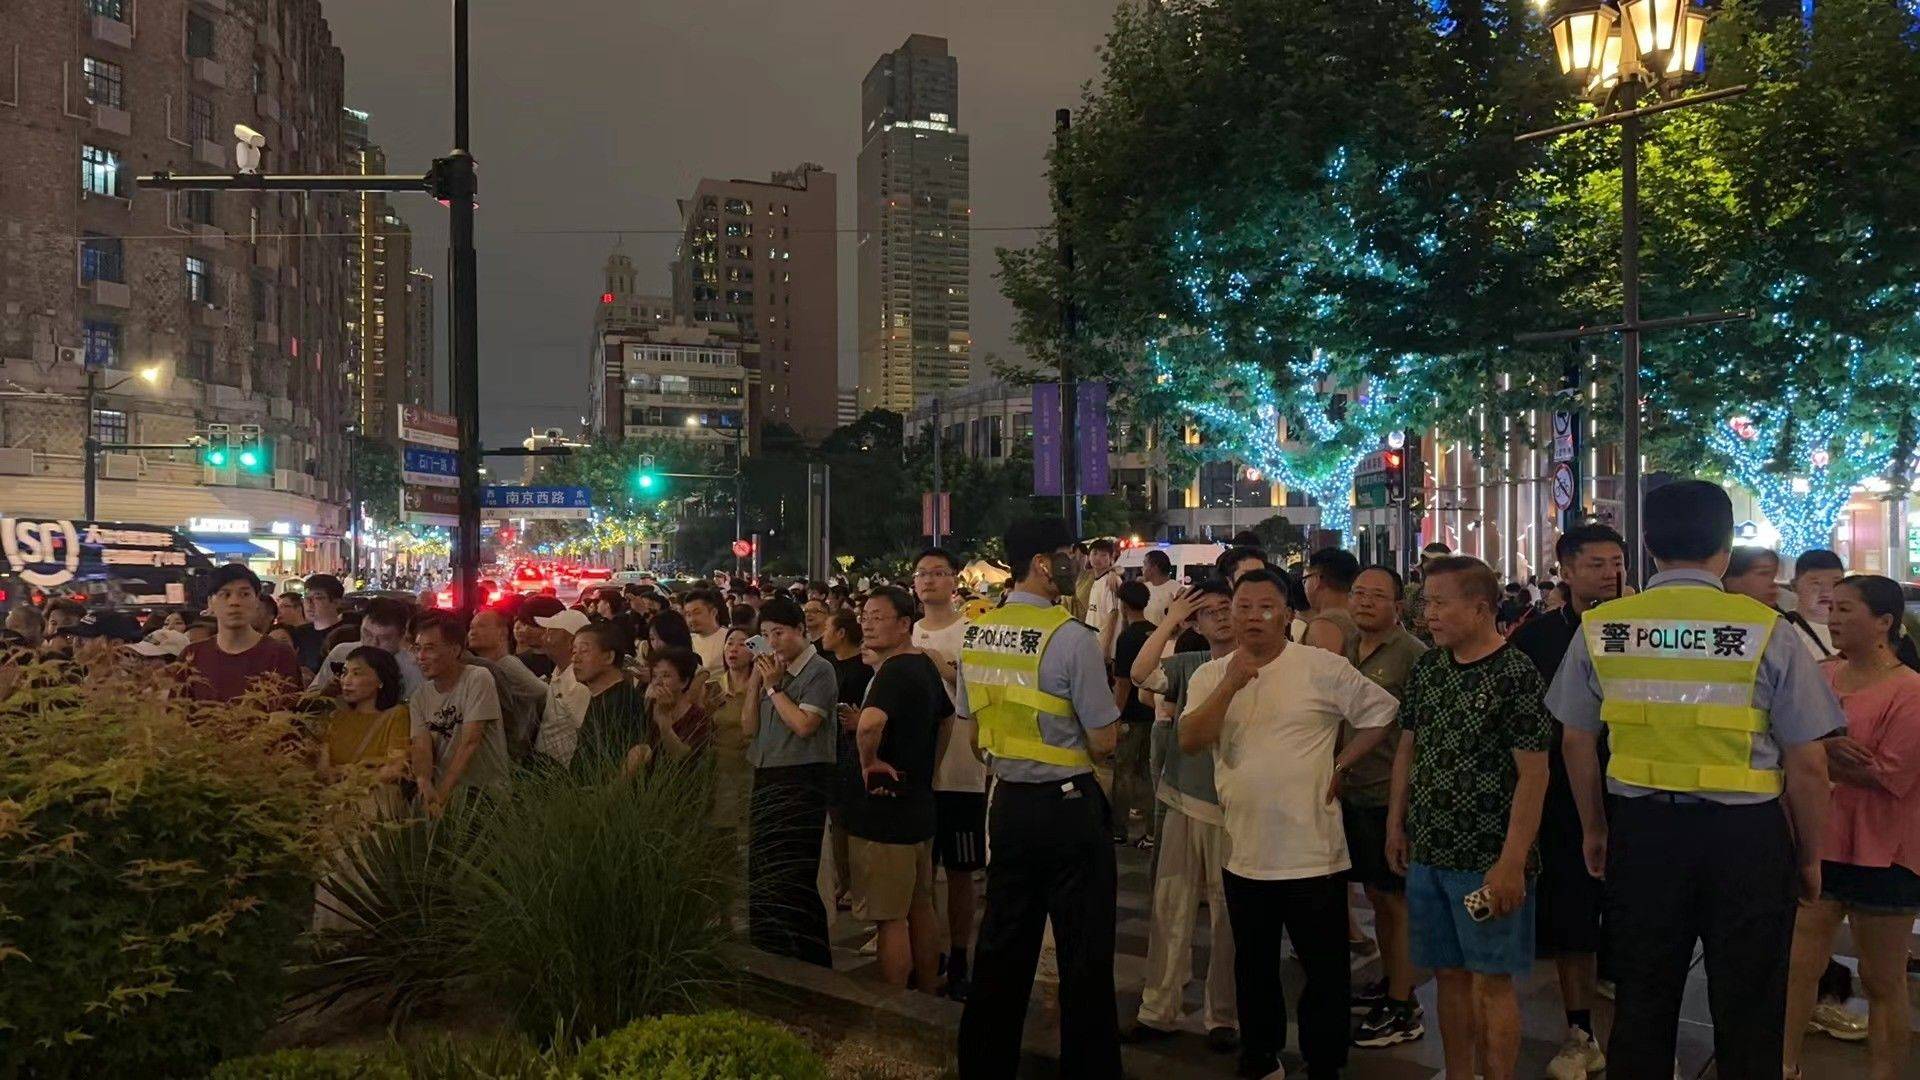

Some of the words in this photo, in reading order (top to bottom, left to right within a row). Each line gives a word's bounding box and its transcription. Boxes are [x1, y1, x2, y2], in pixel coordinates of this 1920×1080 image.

[505, 491, 566, 505] 南京西路
[963, 625, 980, 650] 警
[978, 628, 1018, 649] POLICE
[1020, 628, 1043, 655] 察
[1600, 622, 1632, 654] 警
[1636, 627, 1707, 651] POLICE
[1712, 625, 1748, 657] 察
